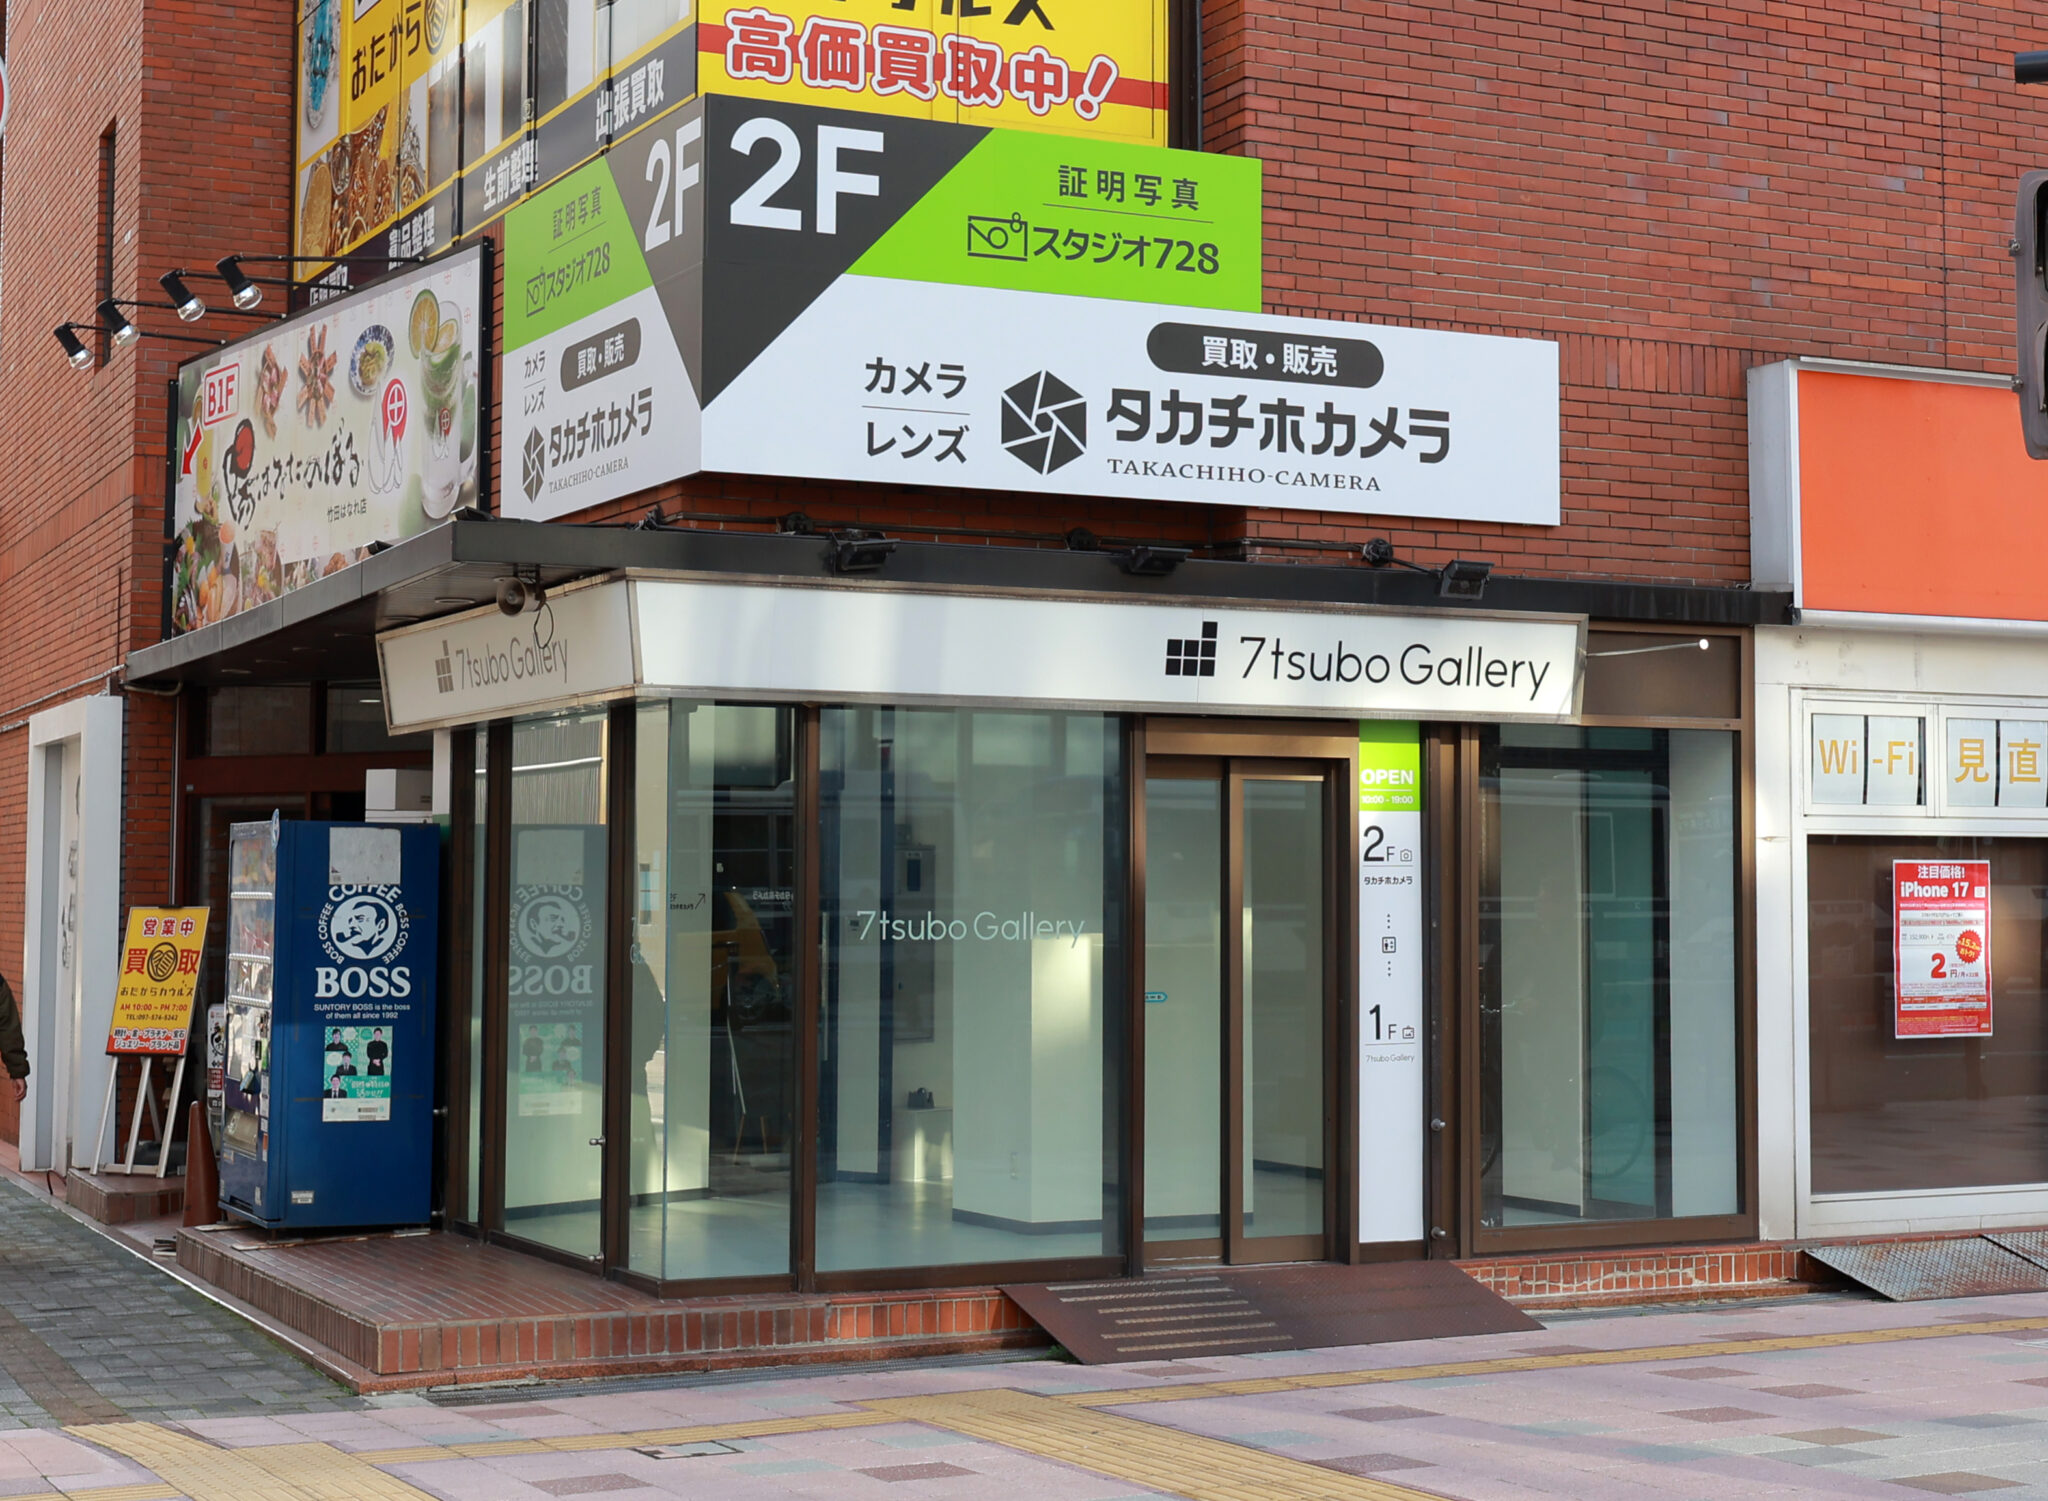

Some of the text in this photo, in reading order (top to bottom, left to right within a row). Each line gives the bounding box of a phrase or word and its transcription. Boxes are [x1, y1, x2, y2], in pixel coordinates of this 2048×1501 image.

[596, 58, 664, 142] 出張買取
[484, 138, 538, 211] 生前整理
[645, 116, 701, 252] 2F
[730, 117, 884, 235] 2F
[1058, 165, 1199, 211] 証明写真
[553, 186, 601, 240] 証明写真
[546, 241, 610, 302] スタジオ728
[1033, 226, 1220, 275] スタジオ728
[524, 350, 546, 379] カメラ
[577, 333, 625, 379] 買取・販売
[1201, 335, 1338, 377] 買取・販売
[208, 374, 235, 417] B1F
[864, 357, 968, 399] カメラ
[524, 386, 546, 417] レンズ
[549, 386, 653, 468] タカチホカメラ
[865, 421, 970, 464] レンズ
[1106, 388, 1450, 464] タカチホカメラ
[456, 633, 568, 690] 7tsubo Gallery
[1240, 637, 1551, 701] 7tsubo Gallery
[1361, 769, 1414, 785] OPEN
[1818, 738, 2041, 784] Wi-Fi 見直
[1363, 825, 1396, 862] 2F
[1364, 876, 1413, 885] タカチホカメラ
[1900, 881, 1969, 898] iPhone 17
[1918, 865, 1966, 879] 注目価格!
[143, 916, 195, 937] 営業中
[318, 902, 345, 964] BOSS COFFEE
[381, 903, 409, 965] BOSS COFFEE
[856, 911, 1085, 948] 7tsubo Gallery
[314, 967, 411, 998] BOSS
[1931, 952, 1947, 979] 2
[120, 1003, 130, 1011] AM
[133, 1003, 152, 1011] 10:00
[172, 1004, 188, 1012] 7:00
[314, 1003, 411, 1012] SUNTORY BOSS is the boss
[326, 1011, 398, 1019] of them all since 1992
[1369, 1004, 1397, 1040] 1F
[1391, 1054, 1415, 1064] Gallery
